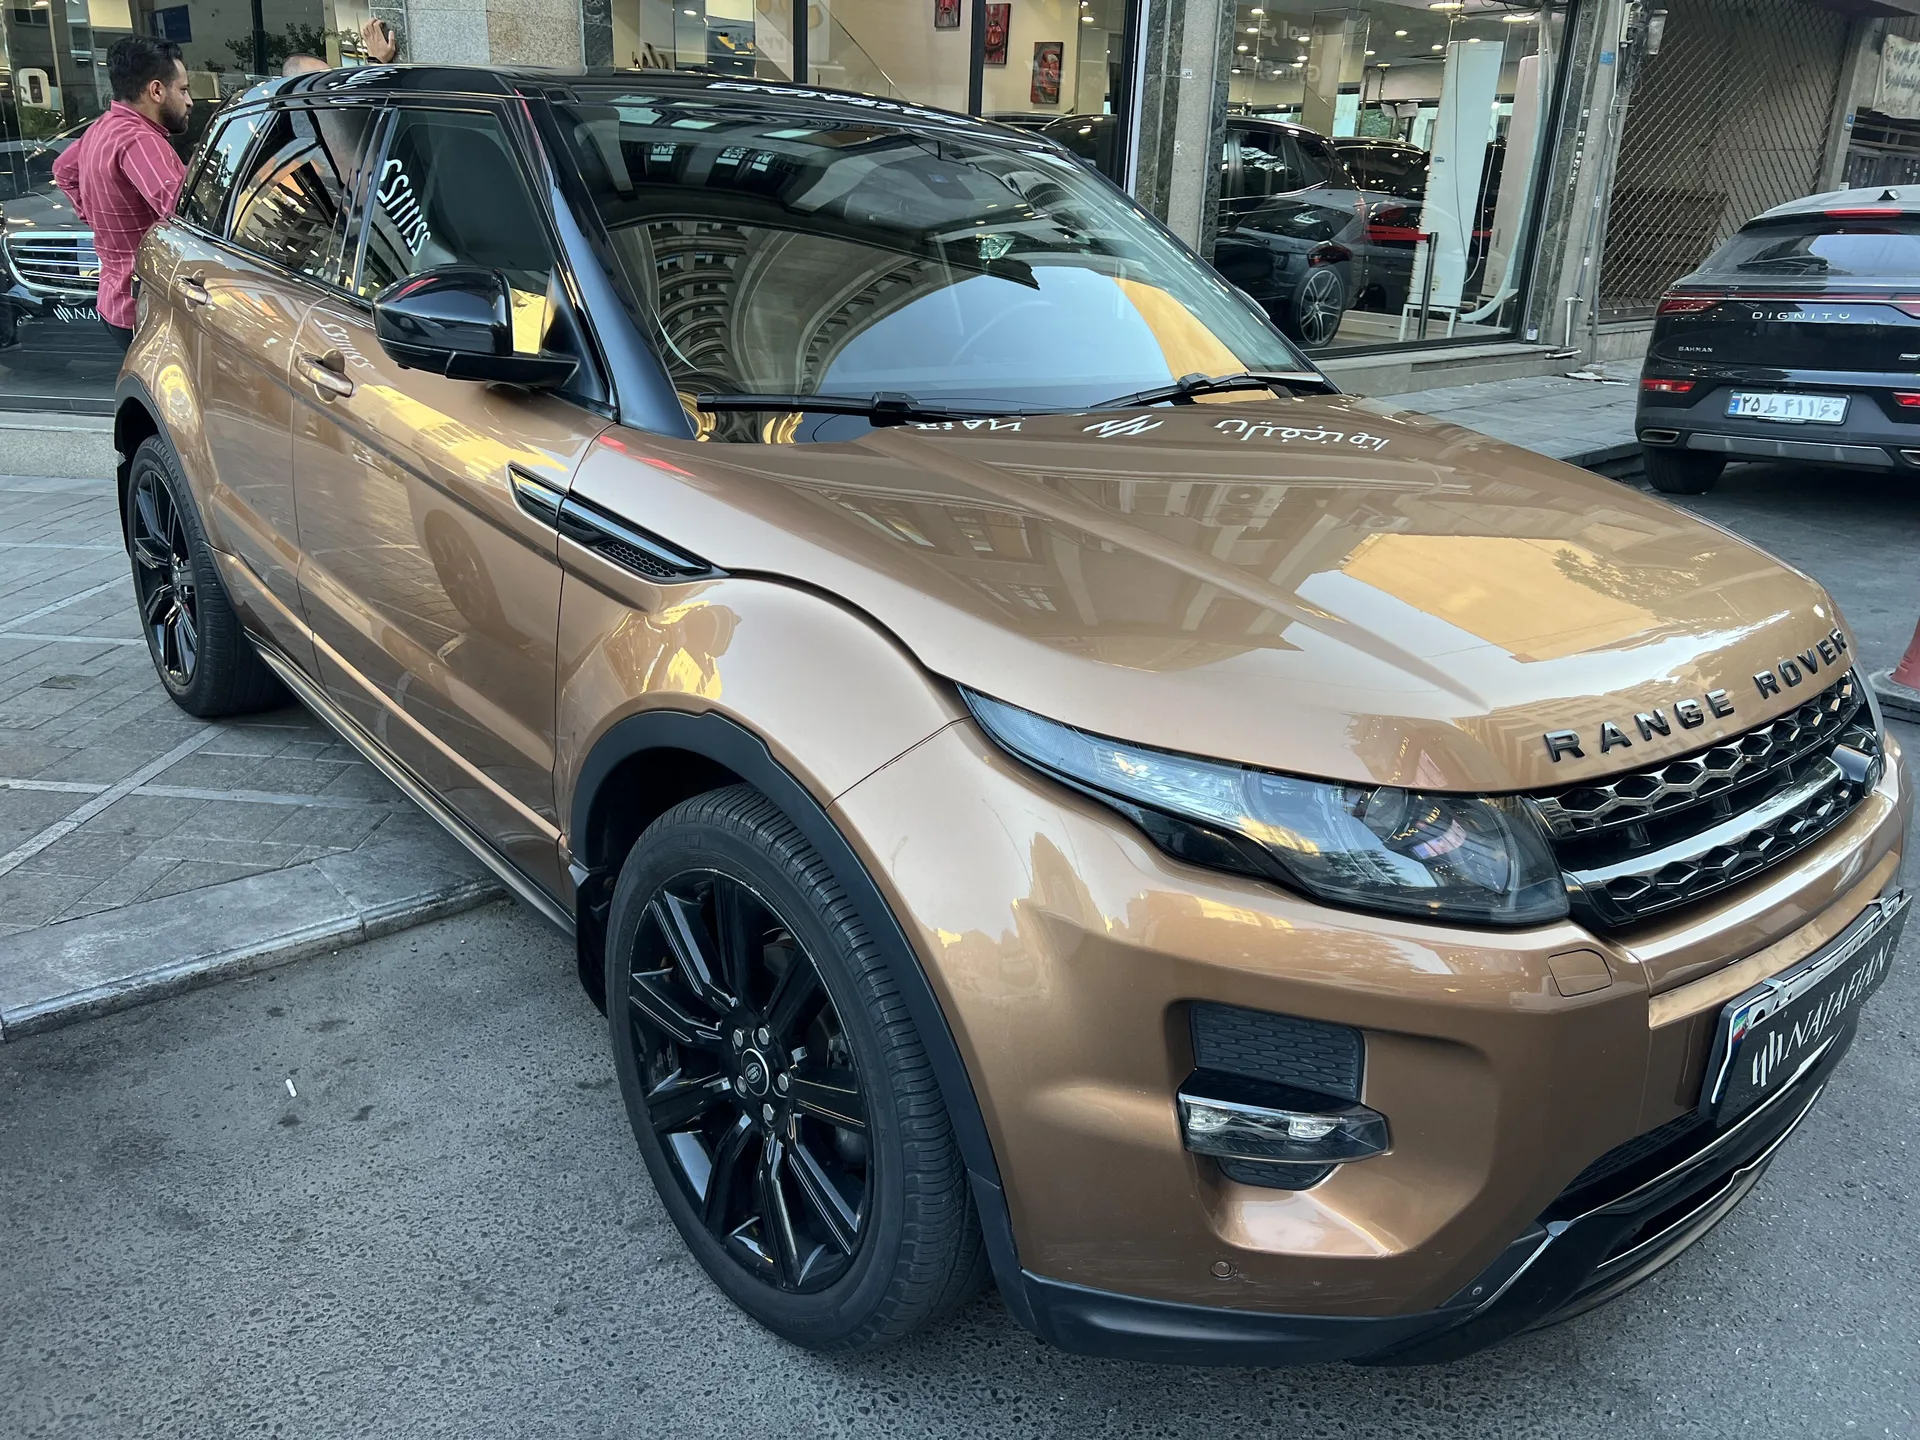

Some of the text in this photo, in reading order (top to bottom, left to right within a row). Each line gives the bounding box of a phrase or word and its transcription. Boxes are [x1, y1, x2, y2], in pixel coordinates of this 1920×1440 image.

[73, 306, 101, 323] NAJ
[1678, 345, 1714, 353] BAHMAN
[1543, 628, 1849, 762] RANGE ROVER
[1783, 936, 1893, 1061] NAJAFIAN
